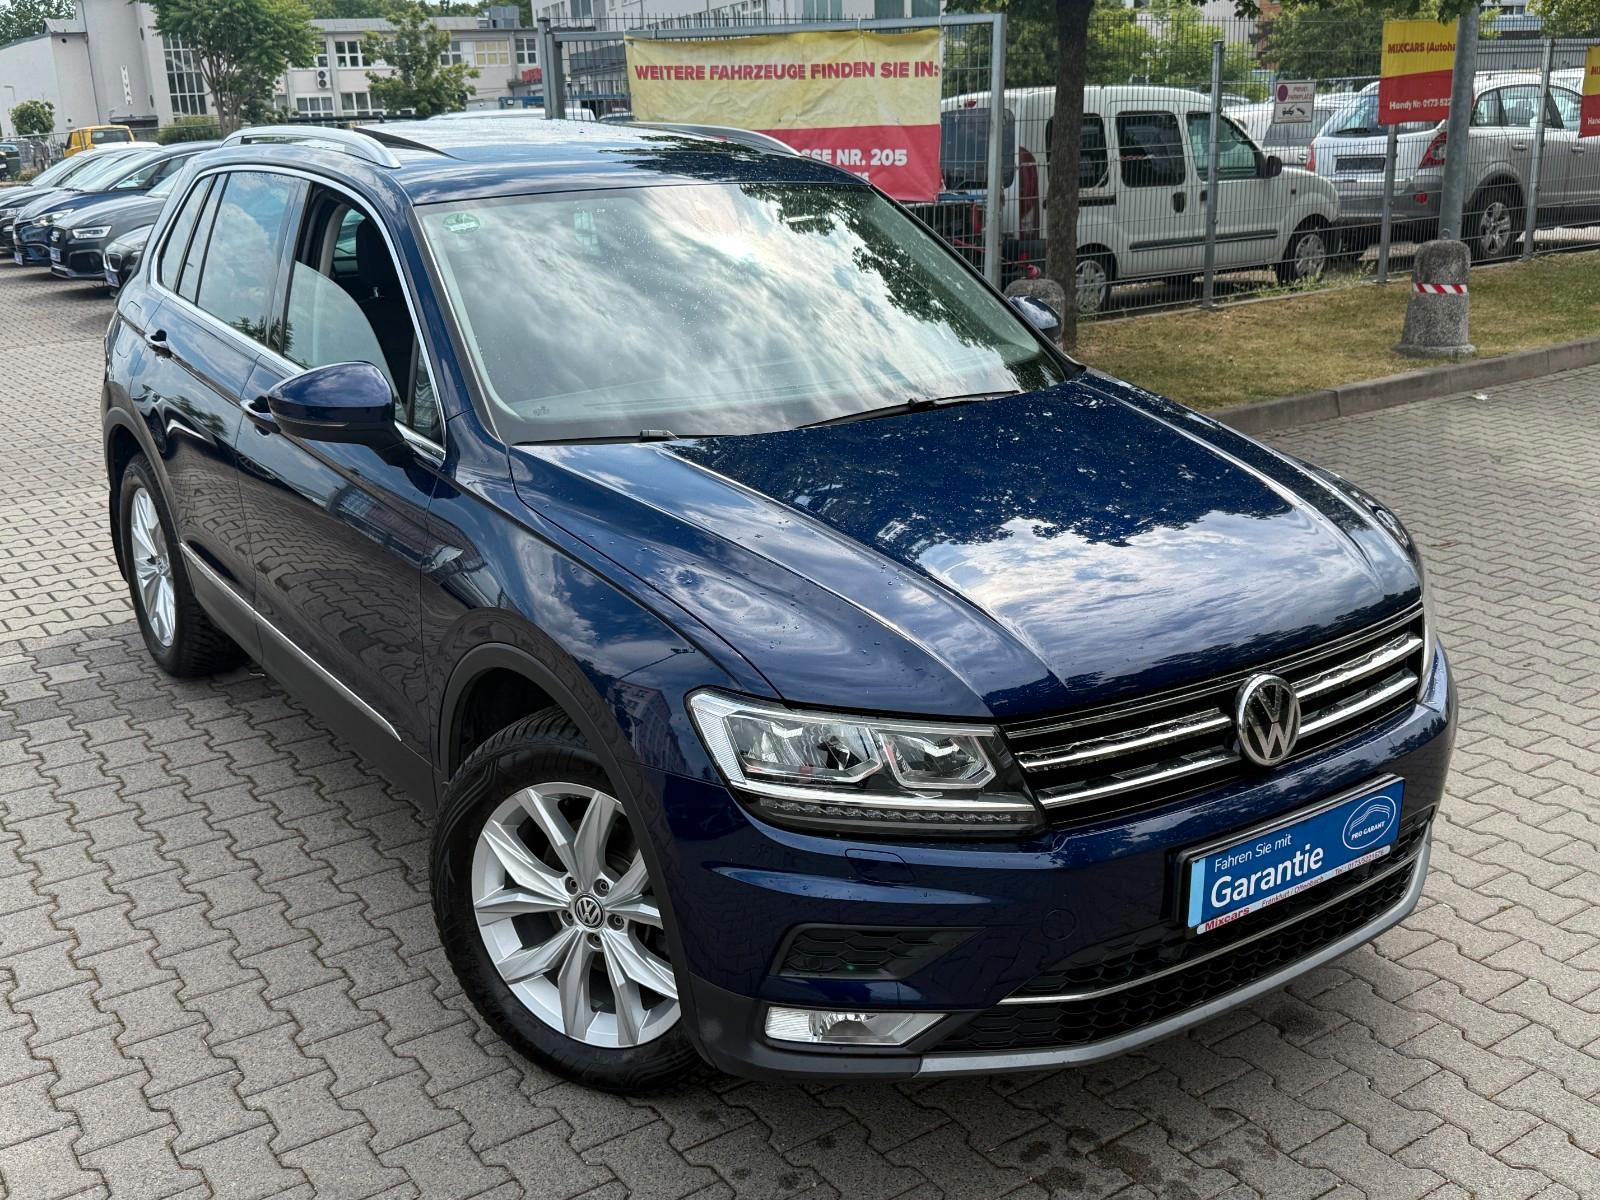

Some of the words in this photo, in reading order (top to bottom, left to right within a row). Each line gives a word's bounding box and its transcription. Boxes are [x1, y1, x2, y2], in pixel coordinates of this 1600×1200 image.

[1388, 42, 1425, 54] MIXCARS
[634, 65, 705, 80] WEITERE
[709, 64, 805, 80] FAHRZEUGE
[811, 62, 875, 79] FINDEN
[880, 62, 909, 78] SIE
[914, 61, 940, 77] IN:
[1389, 100, 1411, 111] Handy
[836, 148, 866, 166] NR.
[870, 148, 907, 166] 205
[1351, 830, 1363, 840] PRO
[1363, 820, 1386, 835] GARANT
[1214, 850, 1252, 873] Fahren
[1255, 842, 1272, 858] Sie
[1274, 833, 1292, 851] mit
[1210, 843, 1324, 908] Garantie
[1204, 907, 1250, 931] Mixcars
